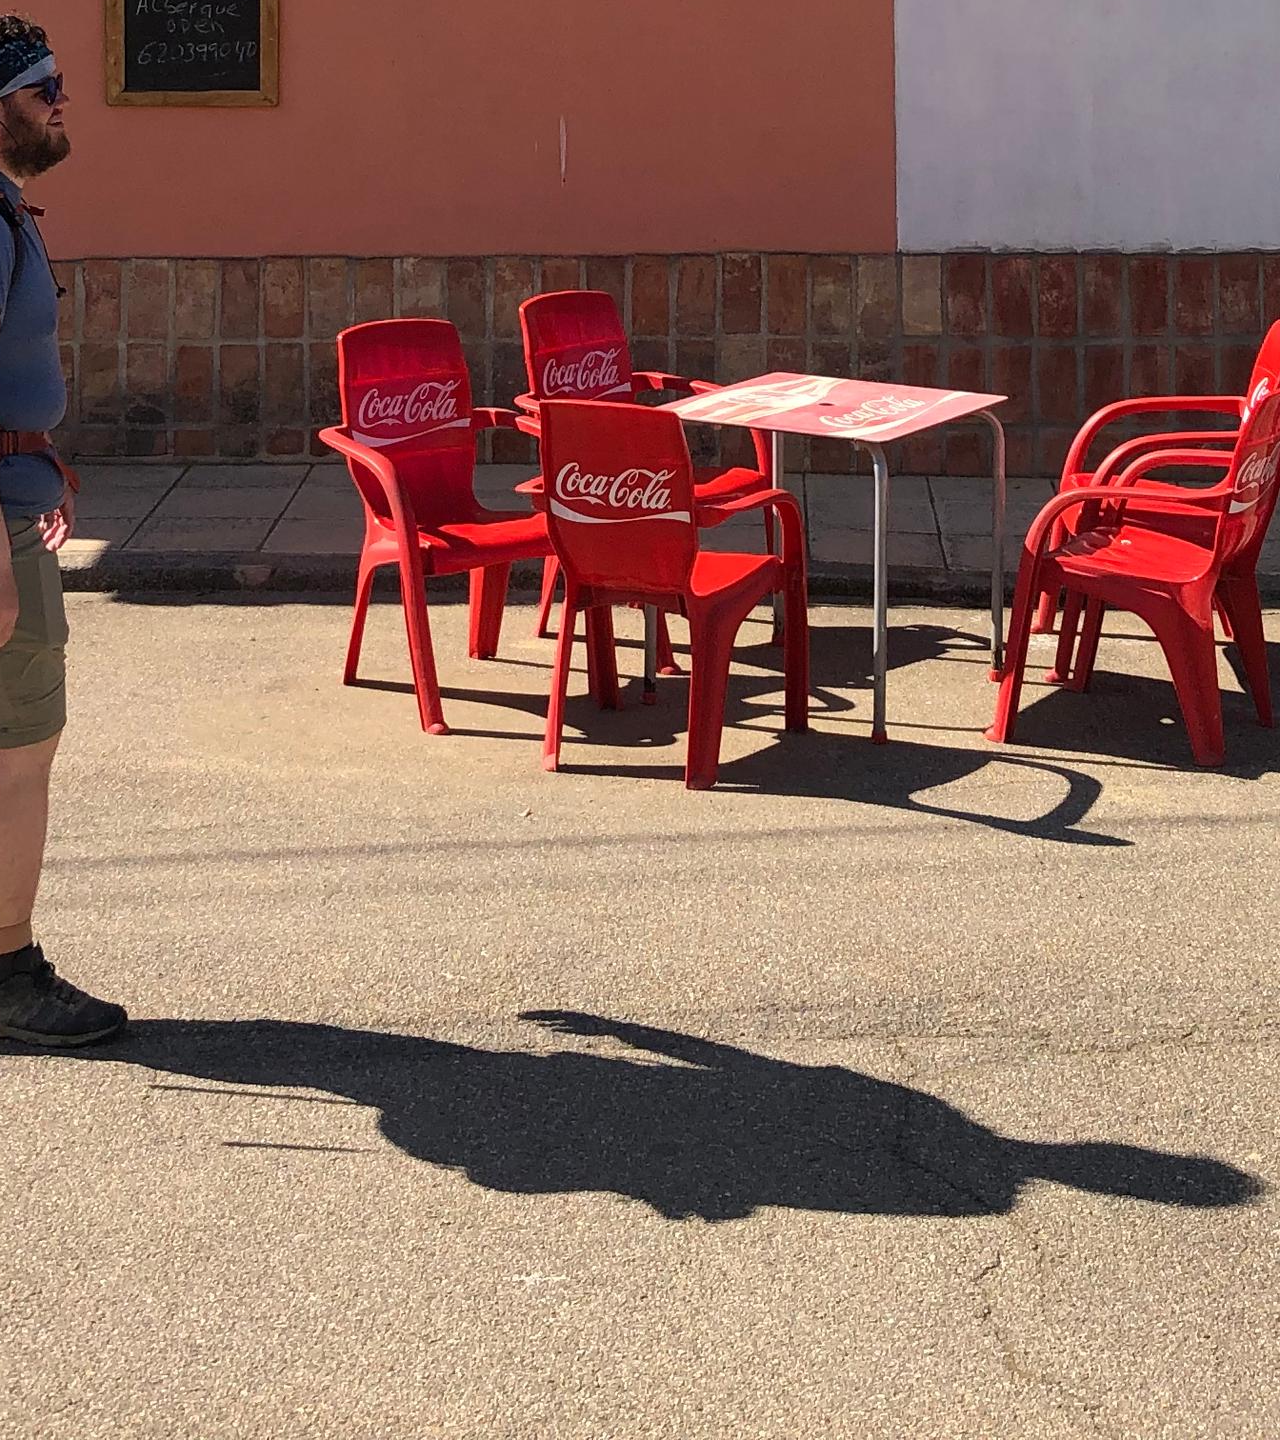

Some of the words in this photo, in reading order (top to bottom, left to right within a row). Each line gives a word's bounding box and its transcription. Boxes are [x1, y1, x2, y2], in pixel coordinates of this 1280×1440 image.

[542, 346, 621, 397] Coca-Cola
[358, 379, 461, 429] Coca-Cola
[556, 461, 677, 511] Coca-Cola
